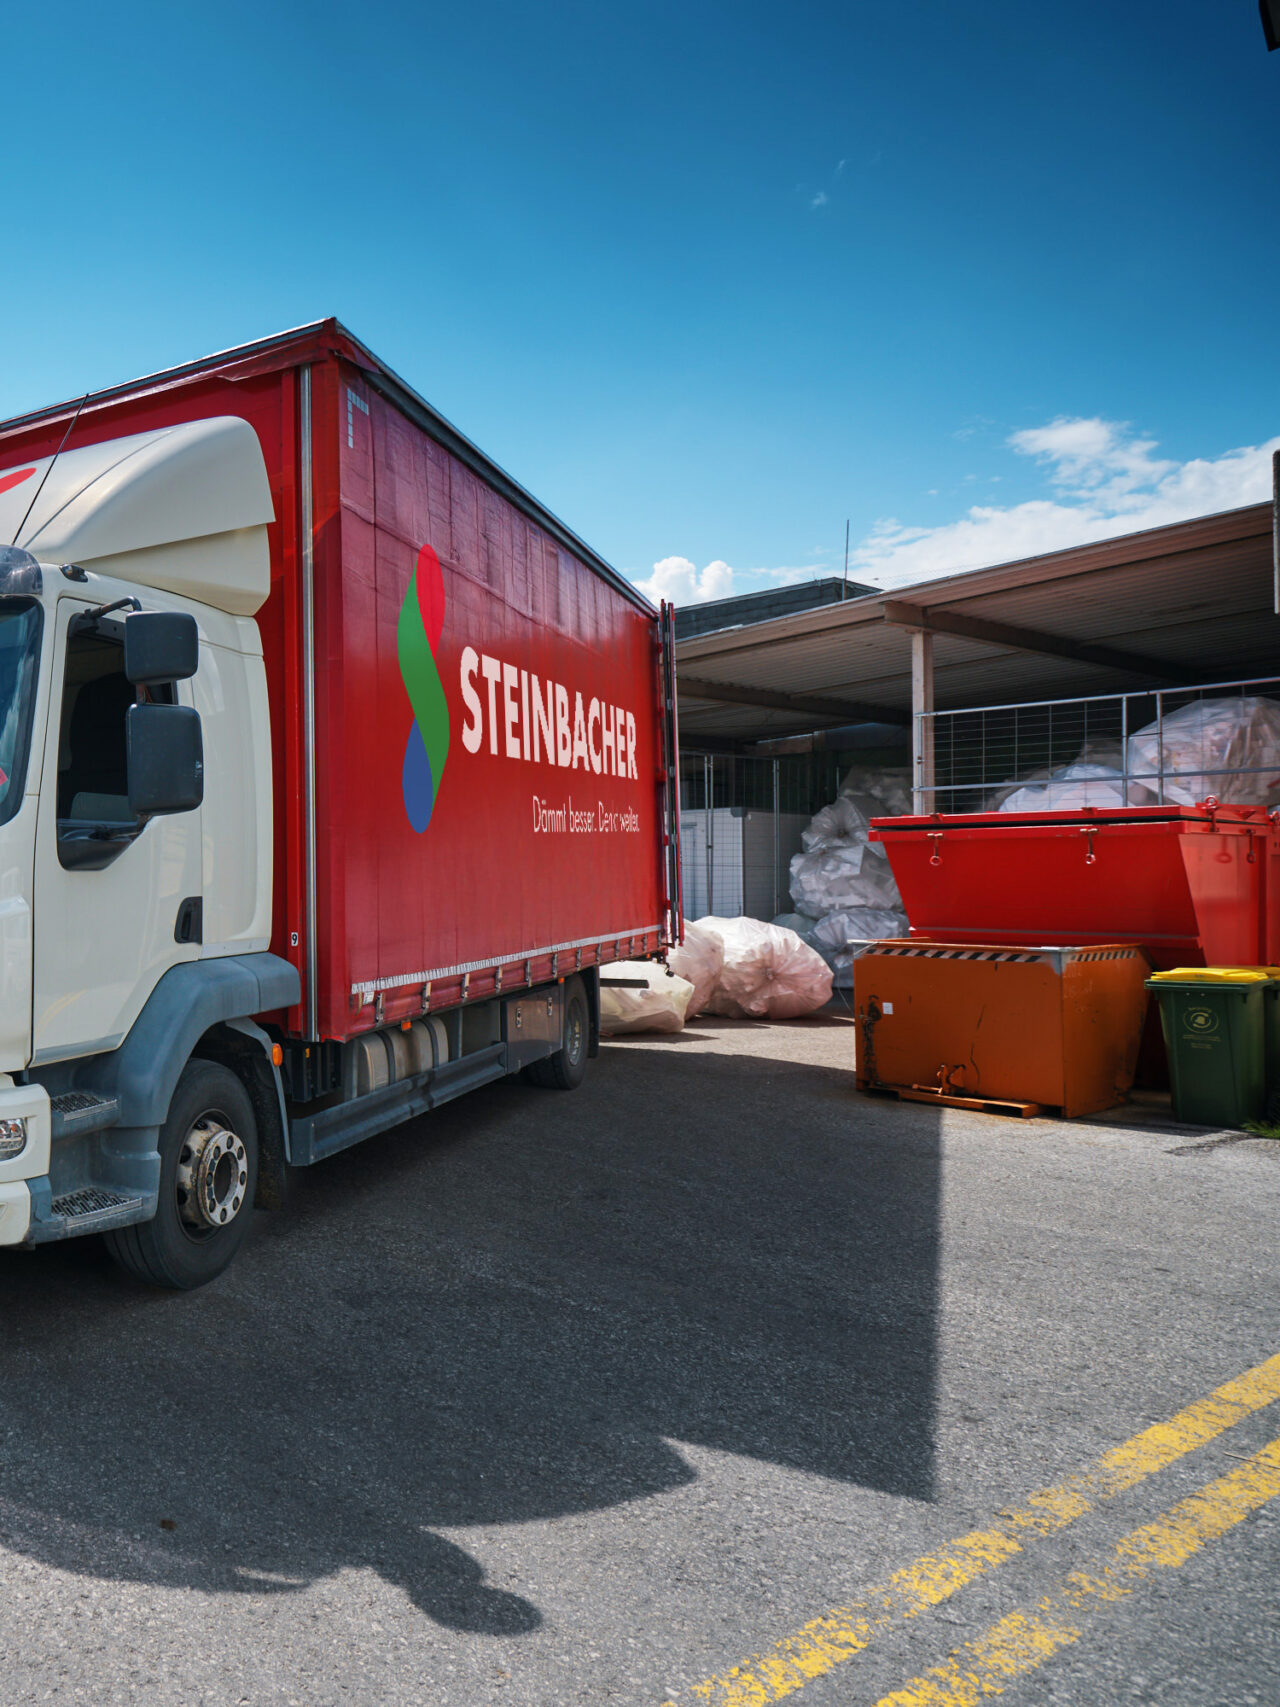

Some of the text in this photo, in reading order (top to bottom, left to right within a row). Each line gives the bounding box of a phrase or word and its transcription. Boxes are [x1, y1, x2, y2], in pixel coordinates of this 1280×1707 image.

[460, 645, 638, 780] STEINBACHER
[568, 795, 597, 832] besser.
[291, 933, 298, 945] 9
